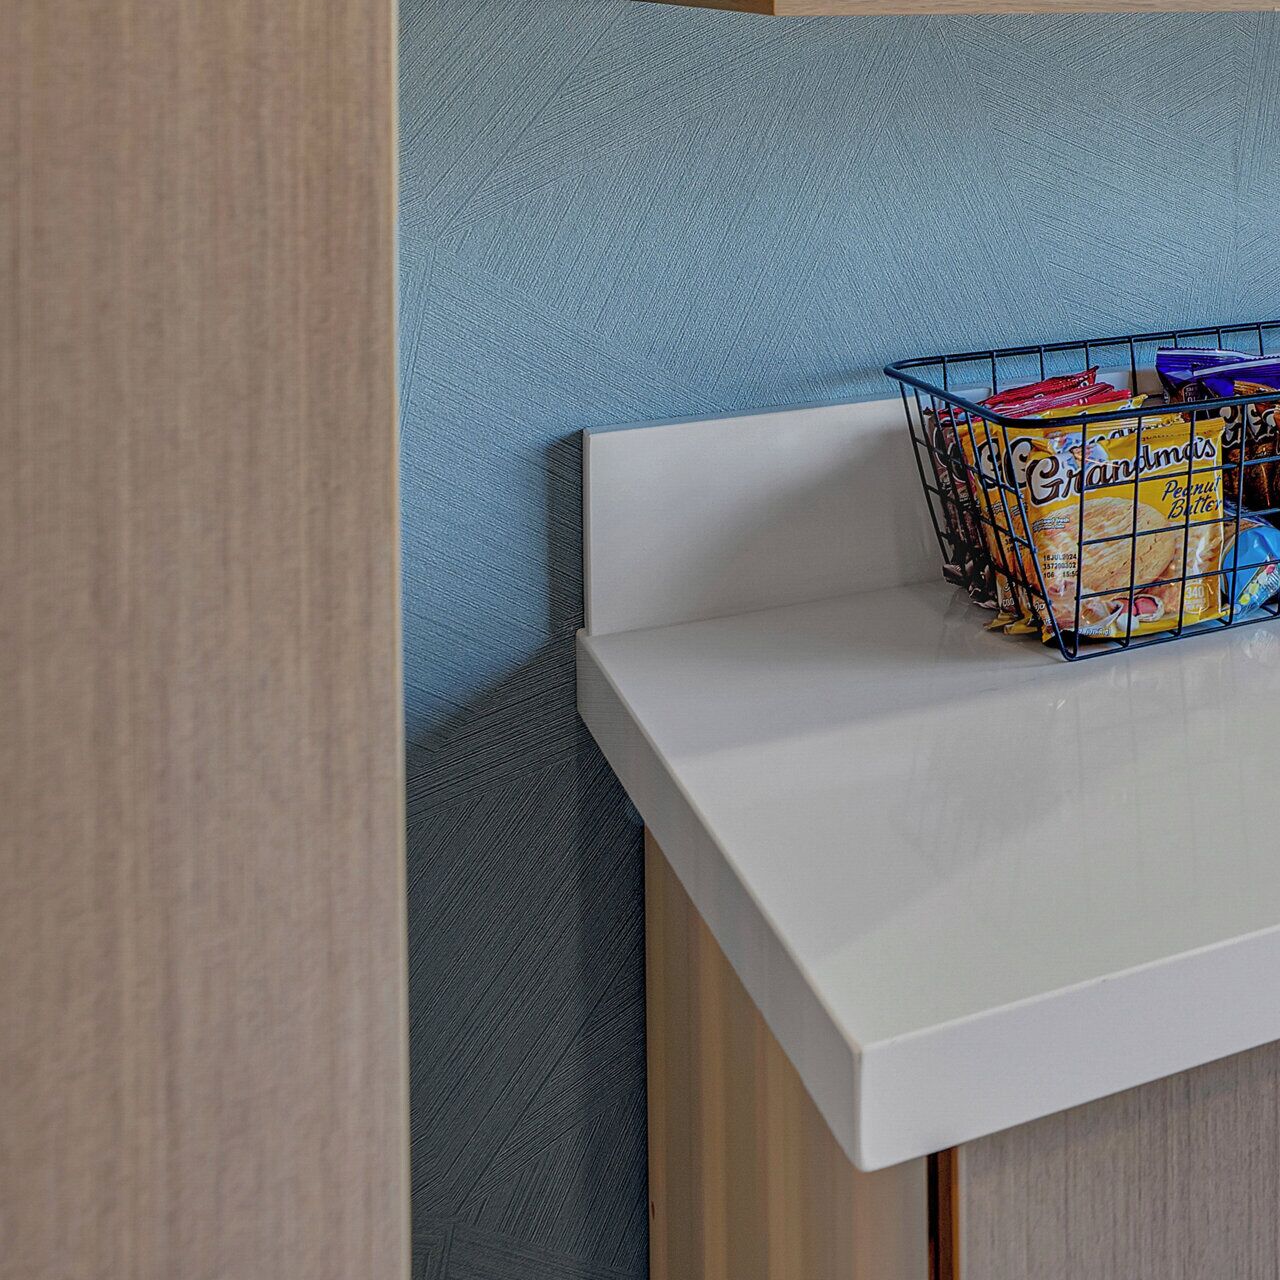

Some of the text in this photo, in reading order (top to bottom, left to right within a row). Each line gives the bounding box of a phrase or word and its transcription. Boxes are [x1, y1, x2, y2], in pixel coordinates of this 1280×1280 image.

[1026, 436, 1216, 507] Grandma's
[1162, 475, 1222, 502] Peanut
[1168, 495, 1223, 520] Butter
[1185, 586, 1203, 598] 340
